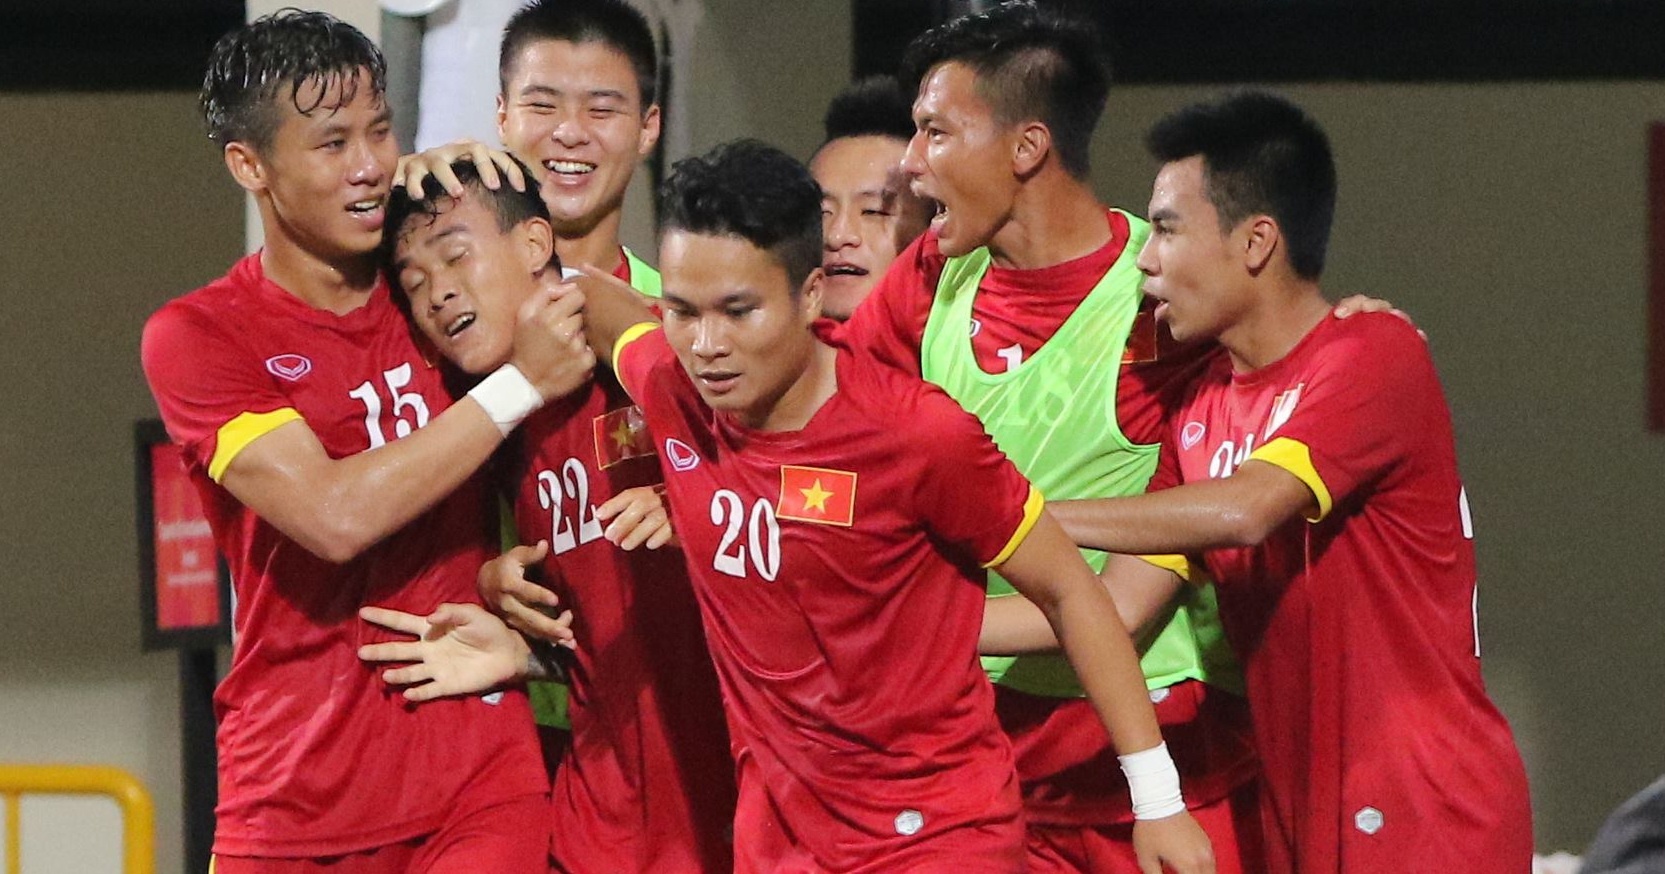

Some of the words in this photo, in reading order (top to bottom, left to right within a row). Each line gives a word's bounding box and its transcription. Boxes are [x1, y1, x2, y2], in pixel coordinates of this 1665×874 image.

[348, 361, 430, 450] 15
[998, 348, 1073, 427] 18
[537, 457, 604, 555] 22
[711, 488, 781, 582] 20
